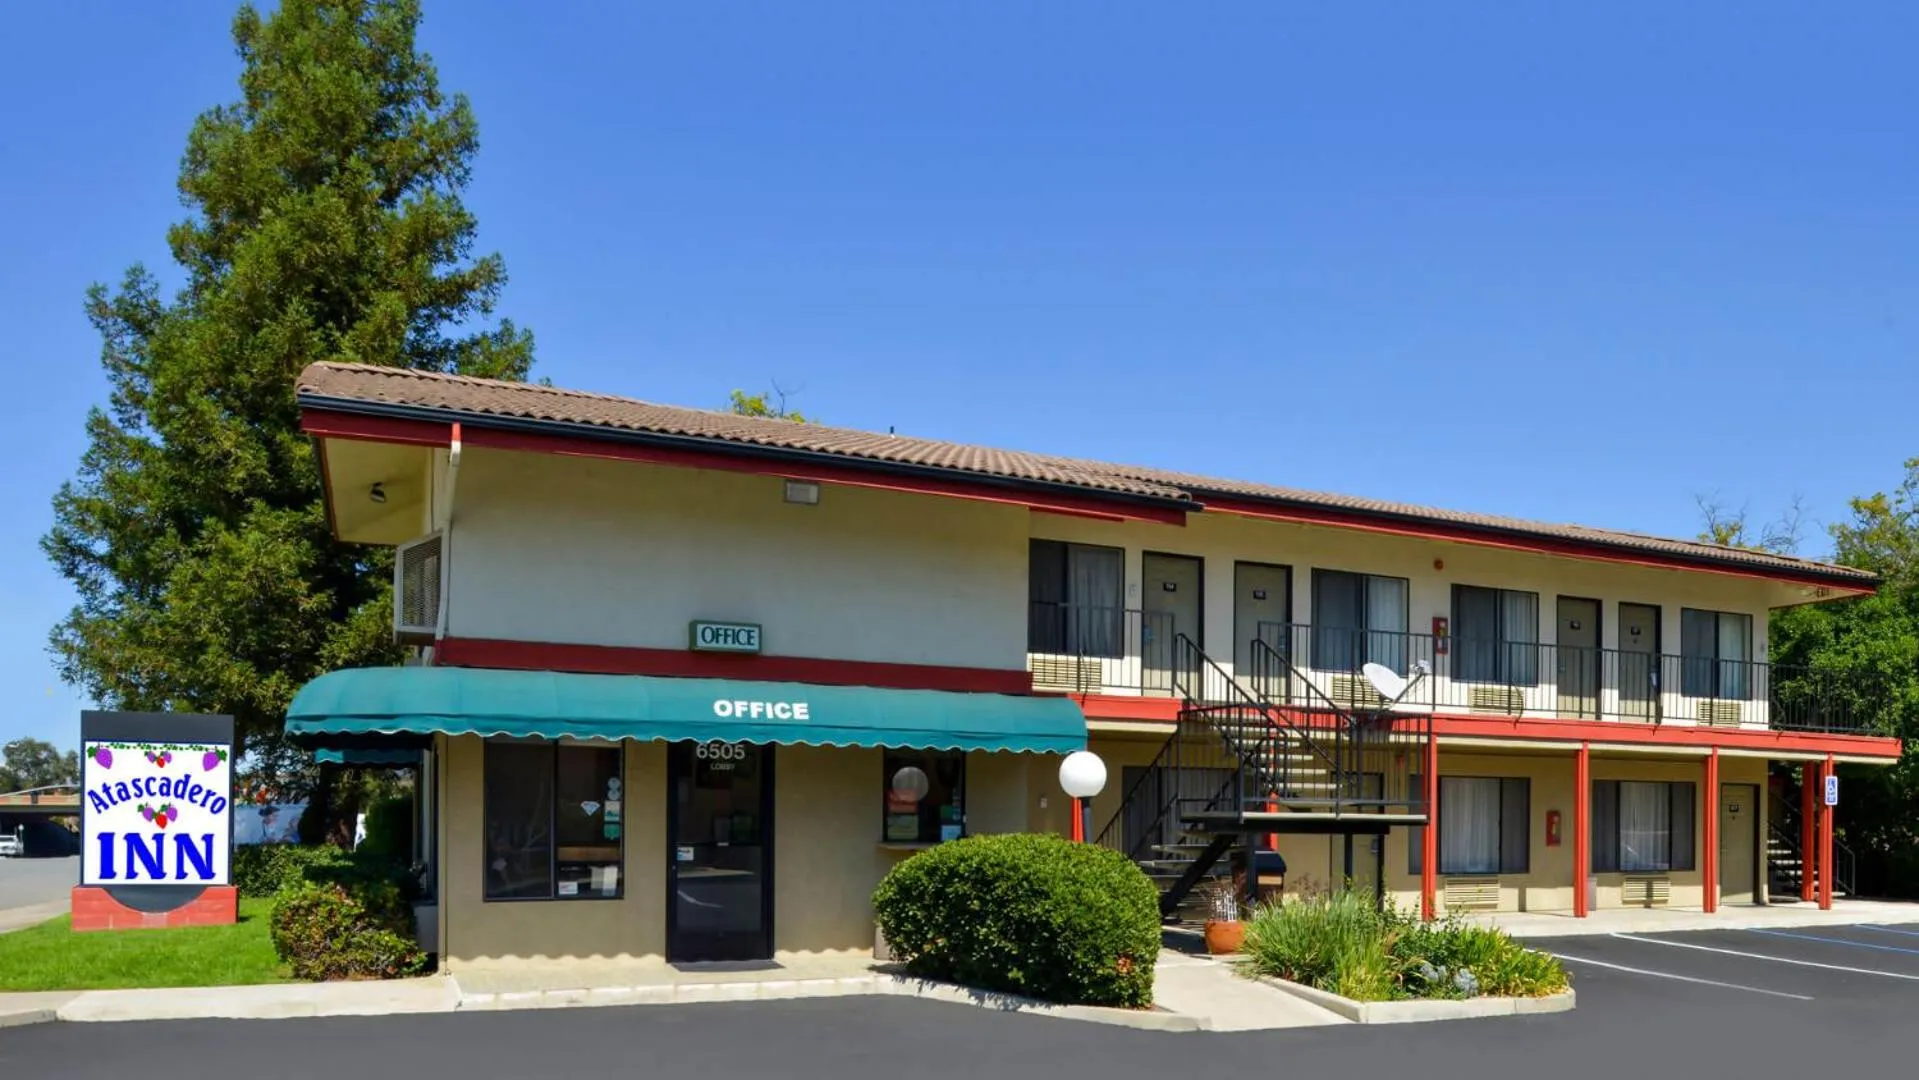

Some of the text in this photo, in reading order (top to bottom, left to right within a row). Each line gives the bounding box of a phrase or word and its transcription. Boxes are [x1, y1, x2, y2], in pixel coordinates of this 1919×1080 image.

[701, 626, 756, 646] OFFICE
[713, 700, 809, 720] OFFICE
[696, 743, 746, 760] 6505
[87, 774, 227, 814] Atascadero
[97, 832, 216, 880] INN
